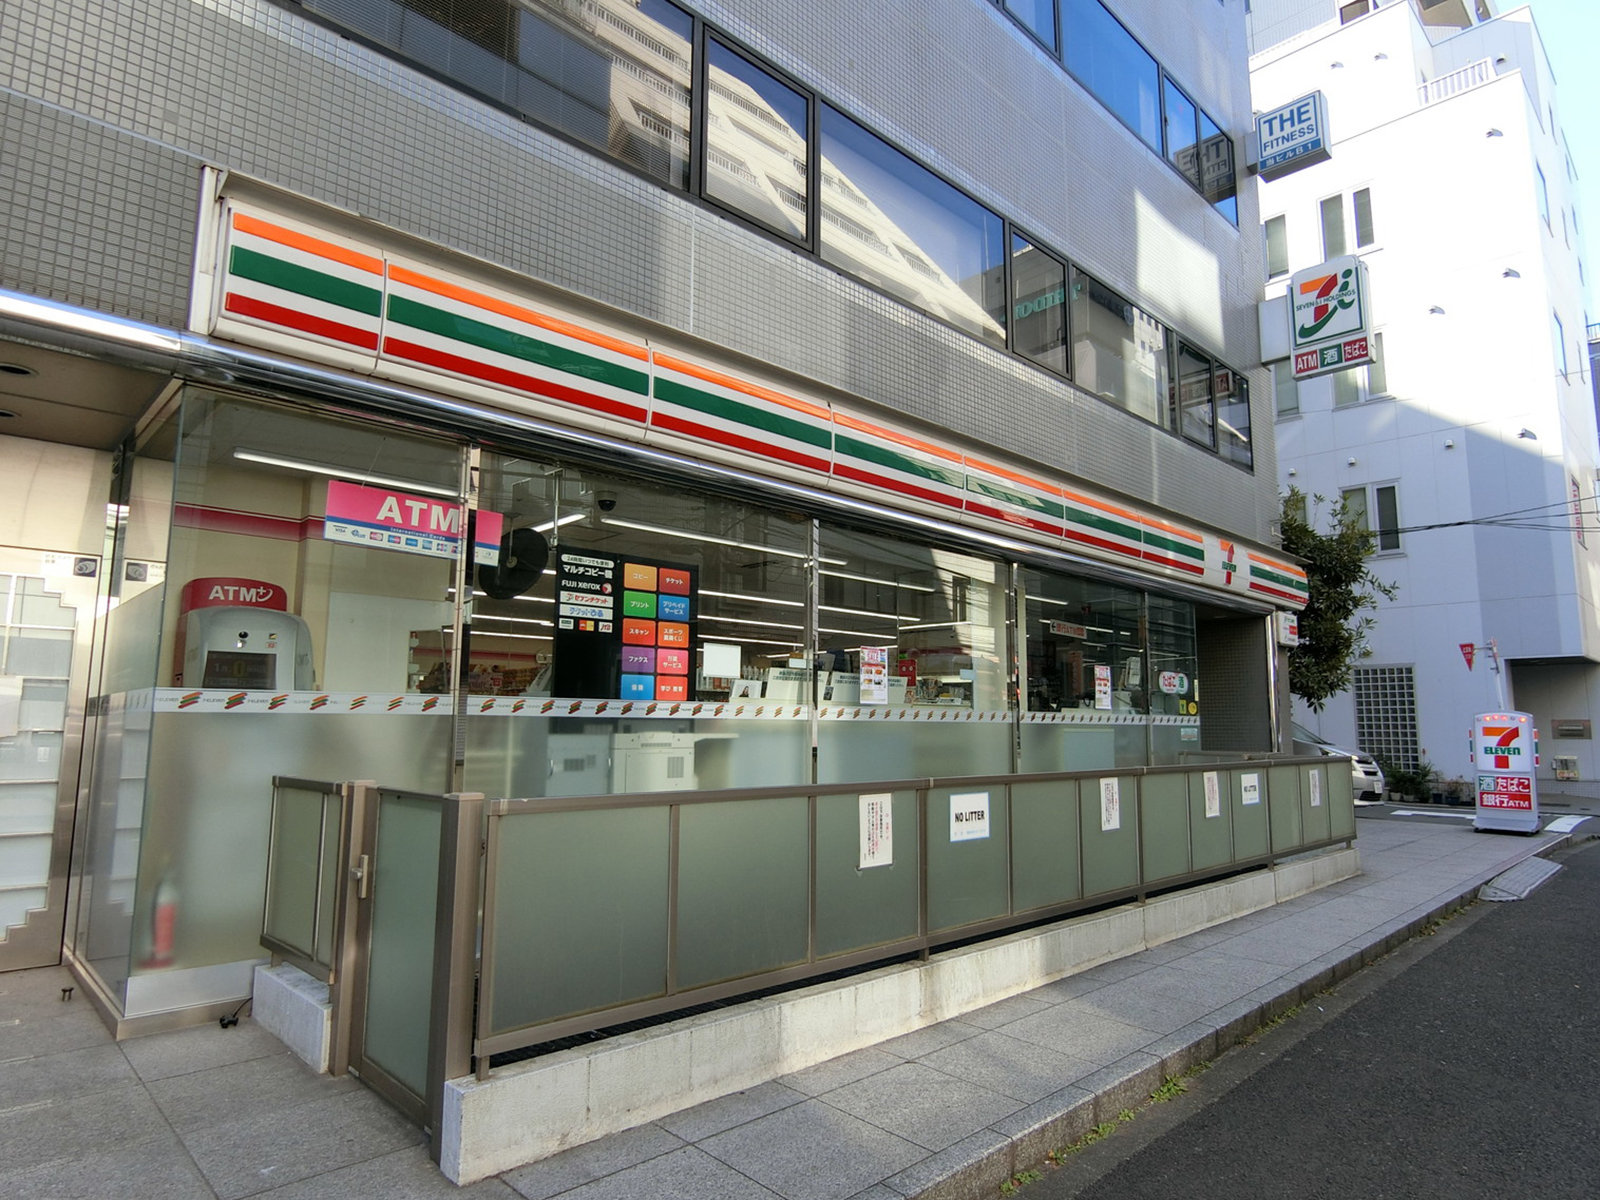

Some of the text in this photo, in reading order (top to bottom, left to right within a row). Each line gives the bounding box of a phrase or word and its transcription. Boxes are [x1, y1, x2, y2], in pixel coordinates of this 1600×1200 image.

[1263, 102, 1311, 136] THE
[1264, 124, 1314, 152] FITNESS
[1323, 289, 1356, 303] HOLDINGS
[1297, 341, 1368, 371] ATM 酒 たばこ
[376, 496, 460, 534] ATM
[562, 565, 613, 579] マルチコピー機
[665, 577, 683, 585] チケット
[574, 595, 608, 605] セブンチケット
[630, 601, 650, 609] プリント
[1480, 777, 1530, 792] 酒 たばこ
[955, 810, 985, 822] NO LITTER
